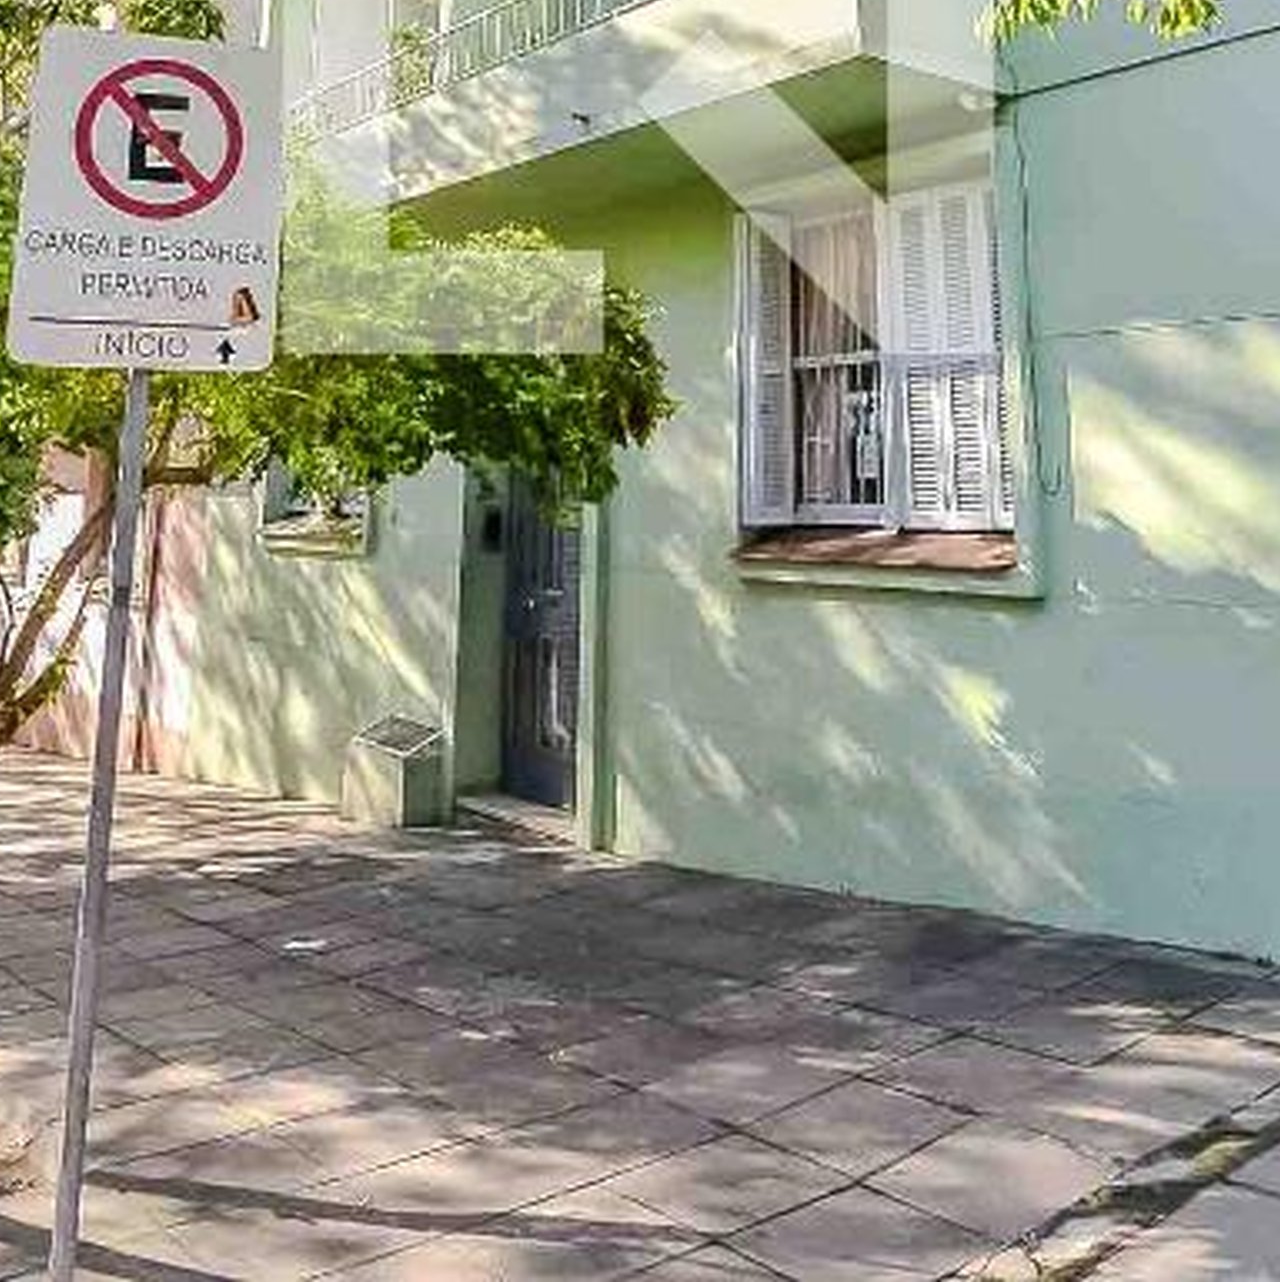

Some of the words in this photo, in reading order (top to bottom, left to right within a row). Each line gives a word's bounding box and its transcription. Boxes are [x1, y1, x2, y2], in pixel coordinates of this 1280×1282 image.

[129, 92, 190, 183] E
[25, 230, 114, 258] CARGA
[119, 236, 133, 258] E
[141, 236, 268, 265] DESCARGA
[80, 273, 209, 301] PERMITIDA
